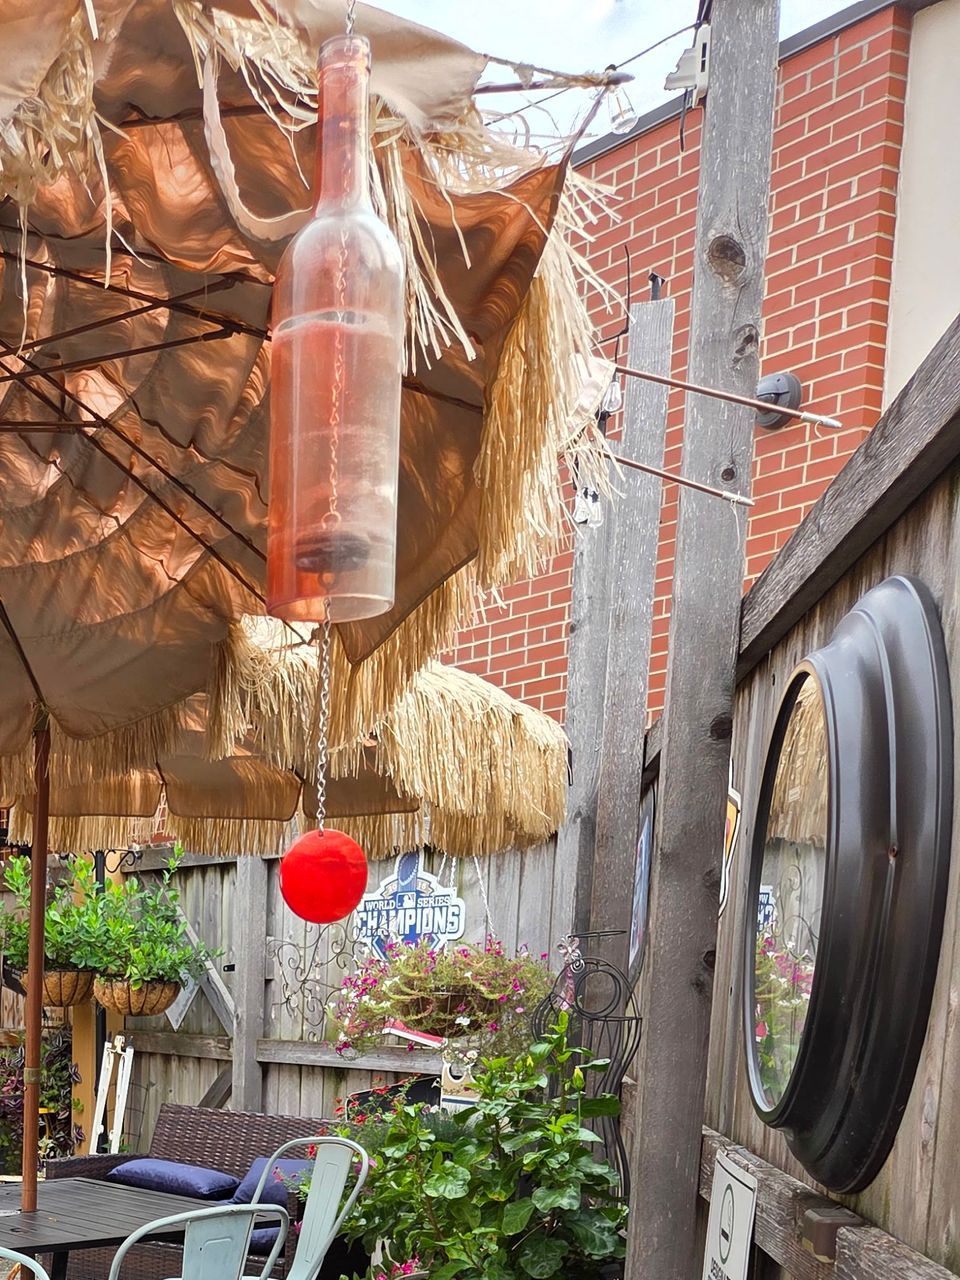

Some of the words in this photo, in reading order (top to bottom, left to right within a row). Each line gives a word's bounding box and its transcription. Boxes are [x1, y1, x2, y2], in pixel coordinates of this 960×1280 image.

[365, 899, 396, 911] WORLD
[417, 895, 450, 908] SERIES
[357, 905, 461, 937] CHAMPIONS
